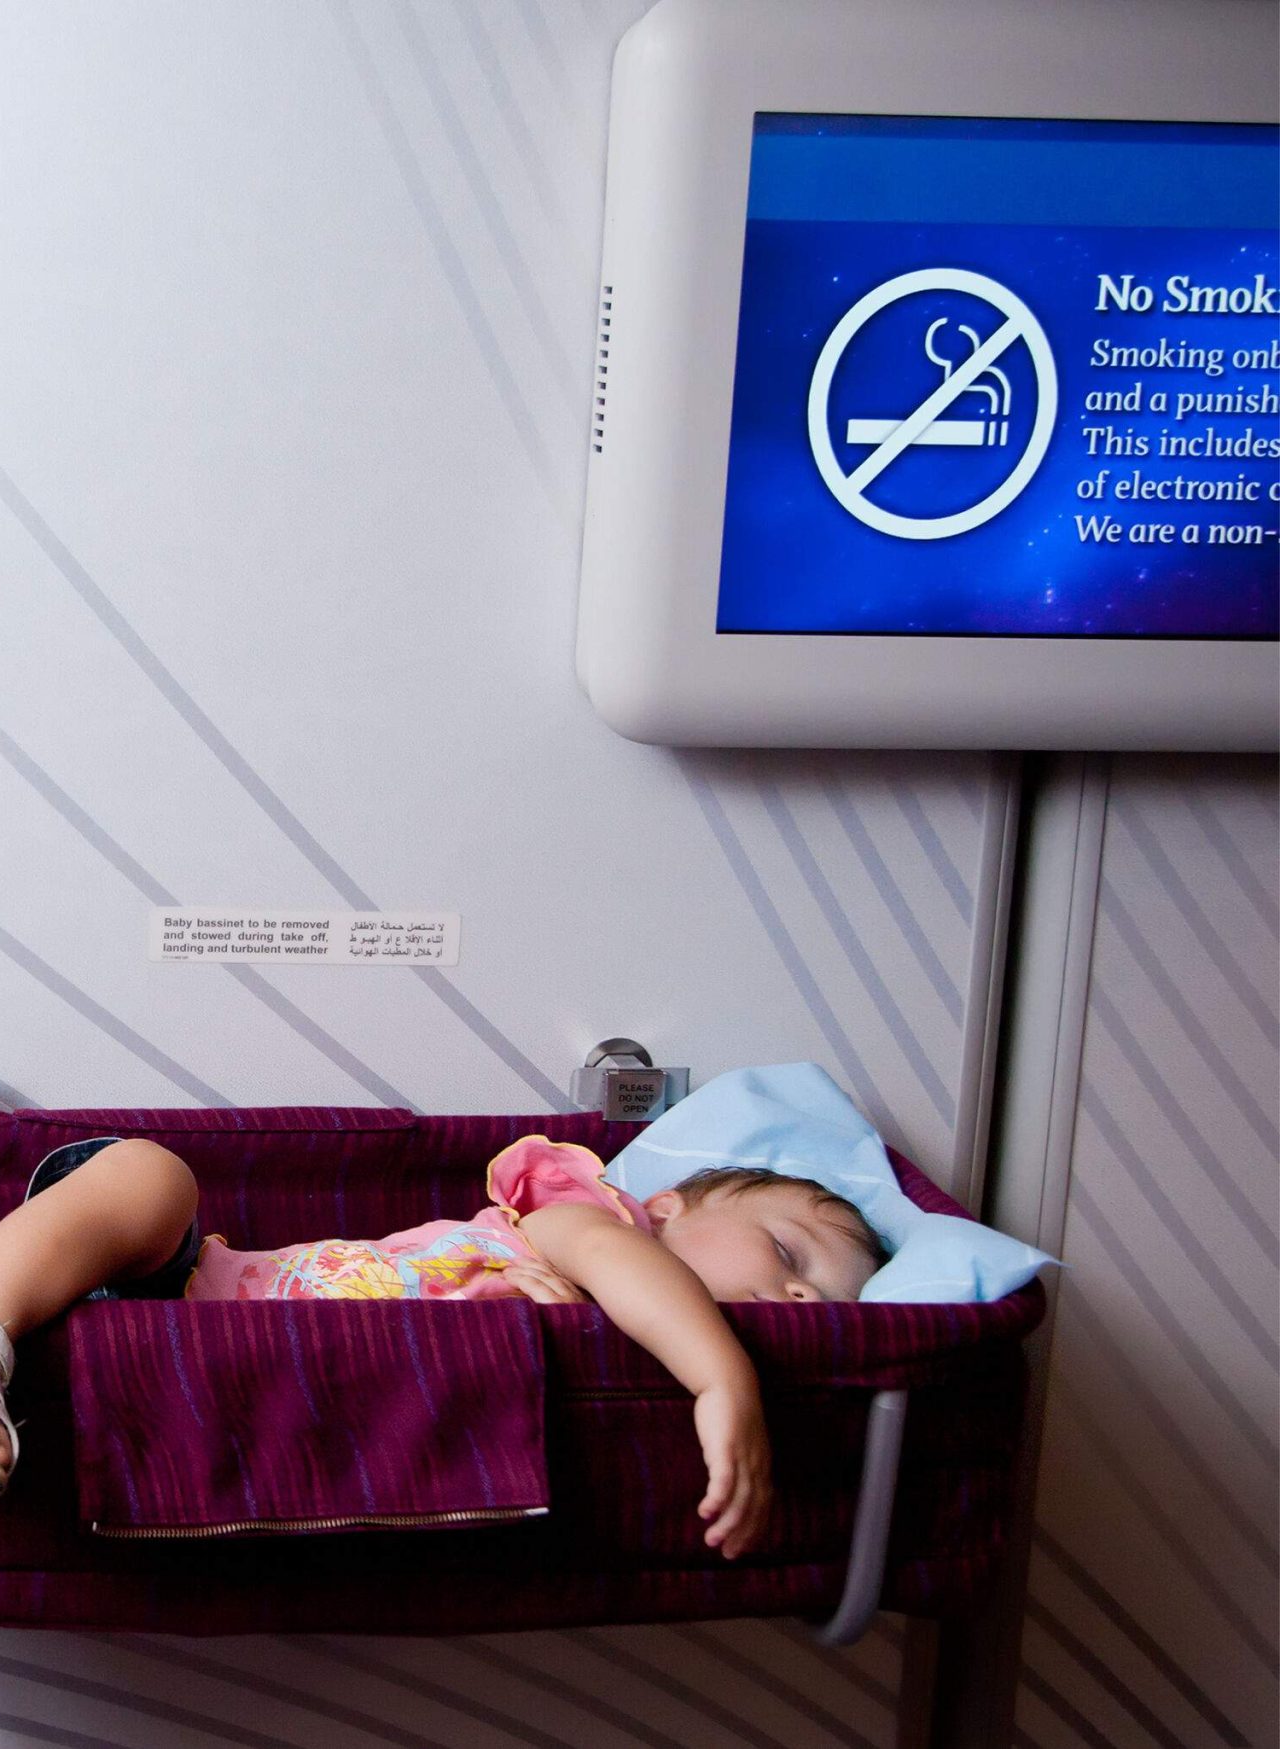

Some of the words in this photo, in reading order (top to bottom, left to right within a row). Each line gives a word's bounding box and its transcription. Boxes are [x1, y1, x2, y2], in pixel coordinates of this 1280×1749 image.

[1095, 274, 1154, 312] No
[1090, 338, 1224, 376] Smoking
[1085, 382, 1142, 411] and
[1149, 392, 1167, 411] a
[1083, 426, 1150, 456] This
[1158, 427, 1280, 457] includes
[1076, 470, 1110, 499] of
[1115, 470, 1261, 500] electronic
[1074, 515, 1122, 543] We
[1129, 523, 1175, 543] are
[1181, 524, 1200, 544] a
[163, 931, 184, 940] and
[191, 931, 231, 940] stowed
[238, 932, 274, 943] during
[281, 932, 304, 942] take
[311, 932, 329, 943] off,
[164, 917, 192, 929] Baby
[197, 918, 244, 928] bassinet
[248, 919, 259, 929] to
[263, 919, 277, 929] be
[281, 920, 330, 930] removed
[163, 943, 204, 955] landing
[207, 944, 228, 953] and
[231, 944, 281, 954] turbulent
[284, 945, 328, 954] weather
[618, 1084, 654, 1092] PLEASE
